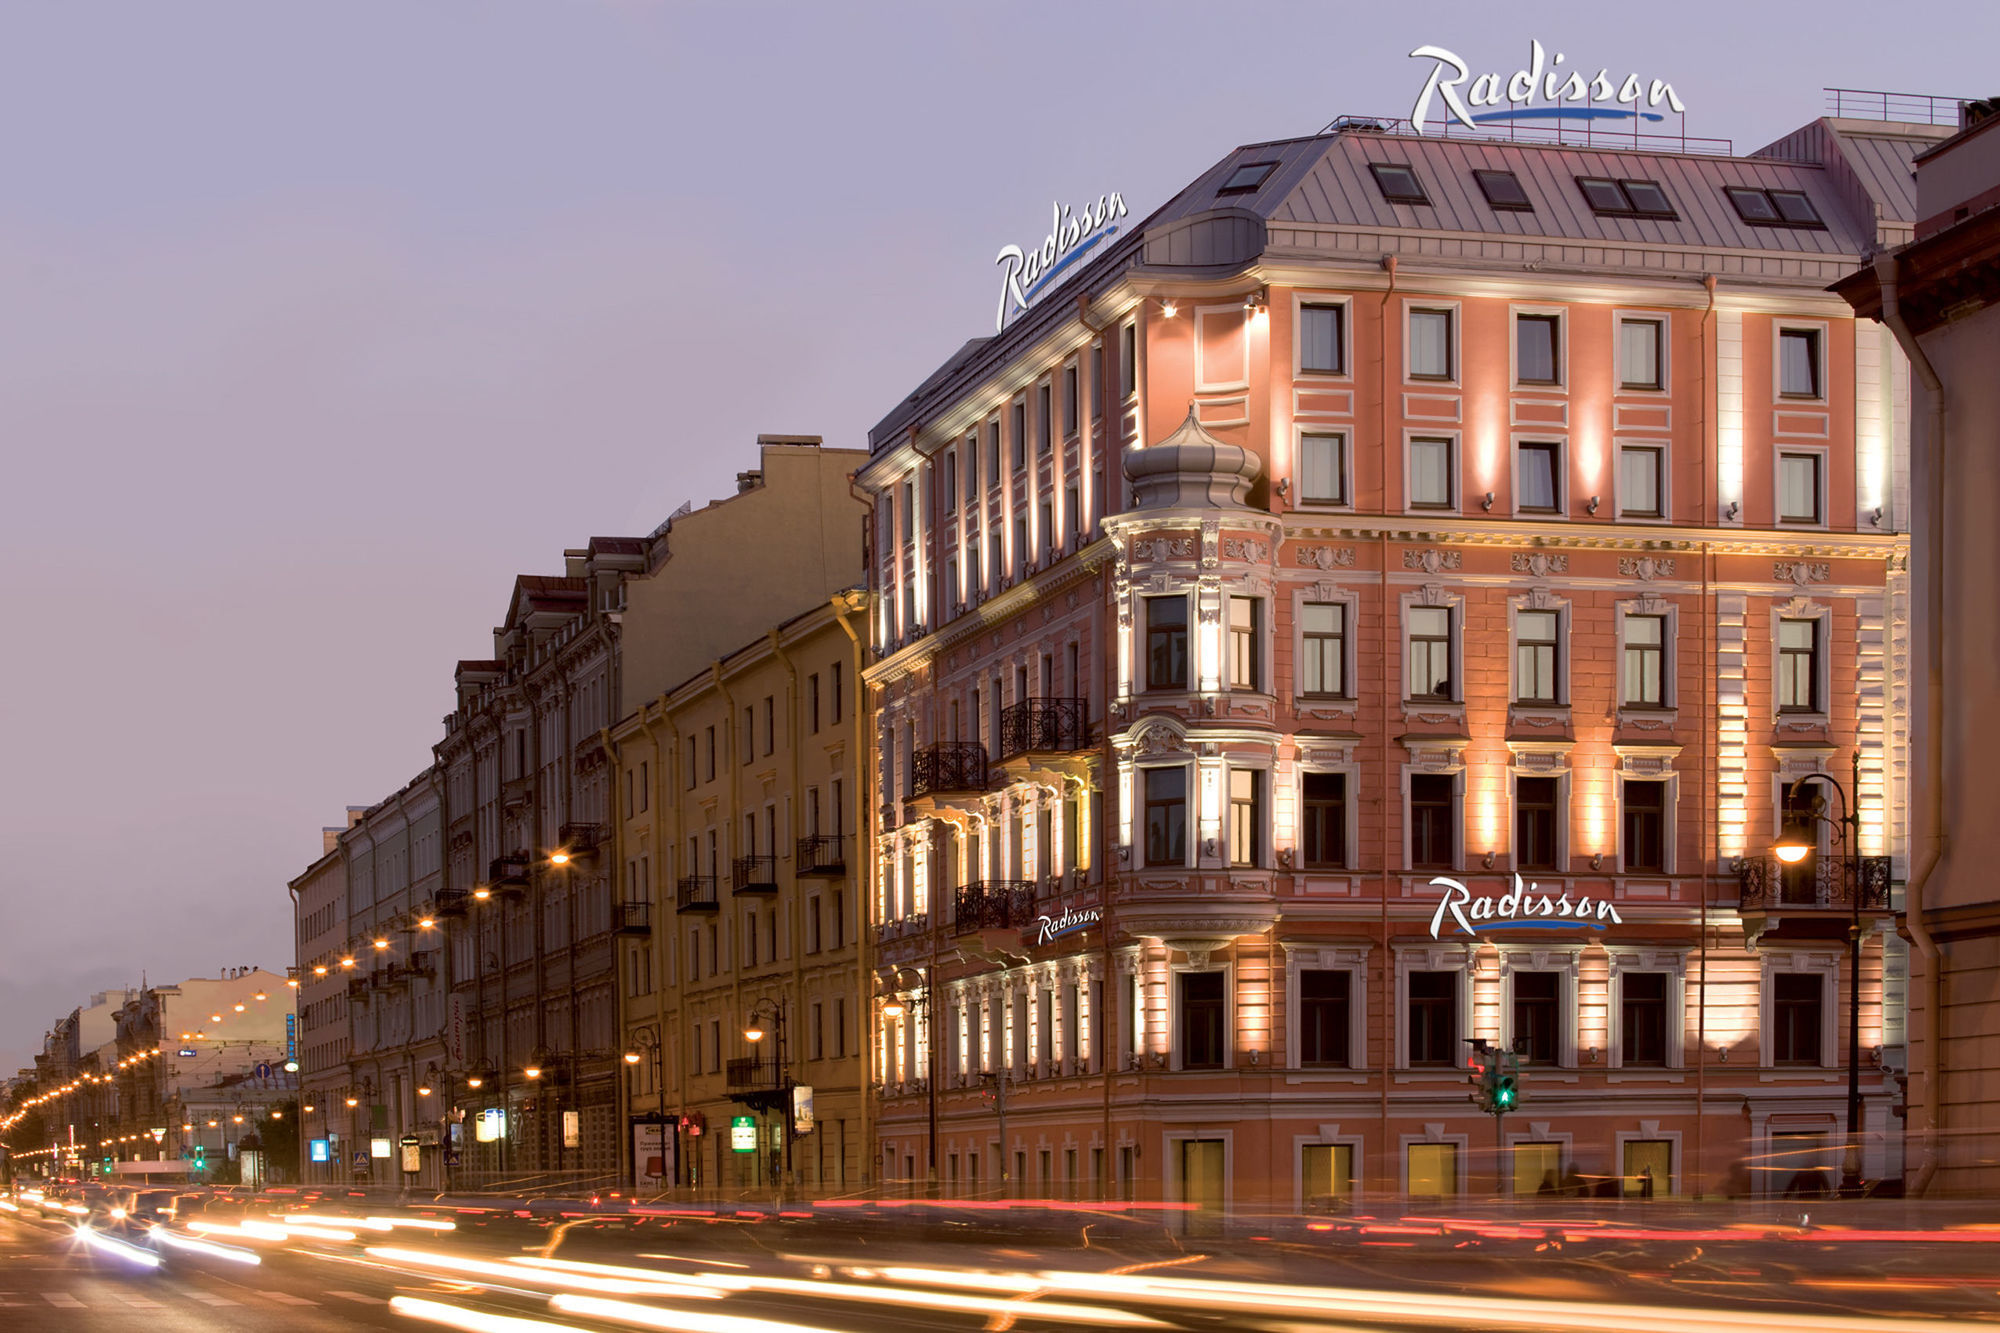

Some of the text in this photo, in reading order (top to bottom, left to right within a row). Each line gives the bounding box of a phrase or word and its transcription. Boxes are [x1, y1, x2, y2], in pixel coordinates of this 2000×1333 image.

[1408, 39, 1685, 136] Radisson
[996, 192, 1128, 335] Radisson
[1038, 906, 1100, 946] Radisson
[1428, 873, 1622, 940] Radisson
